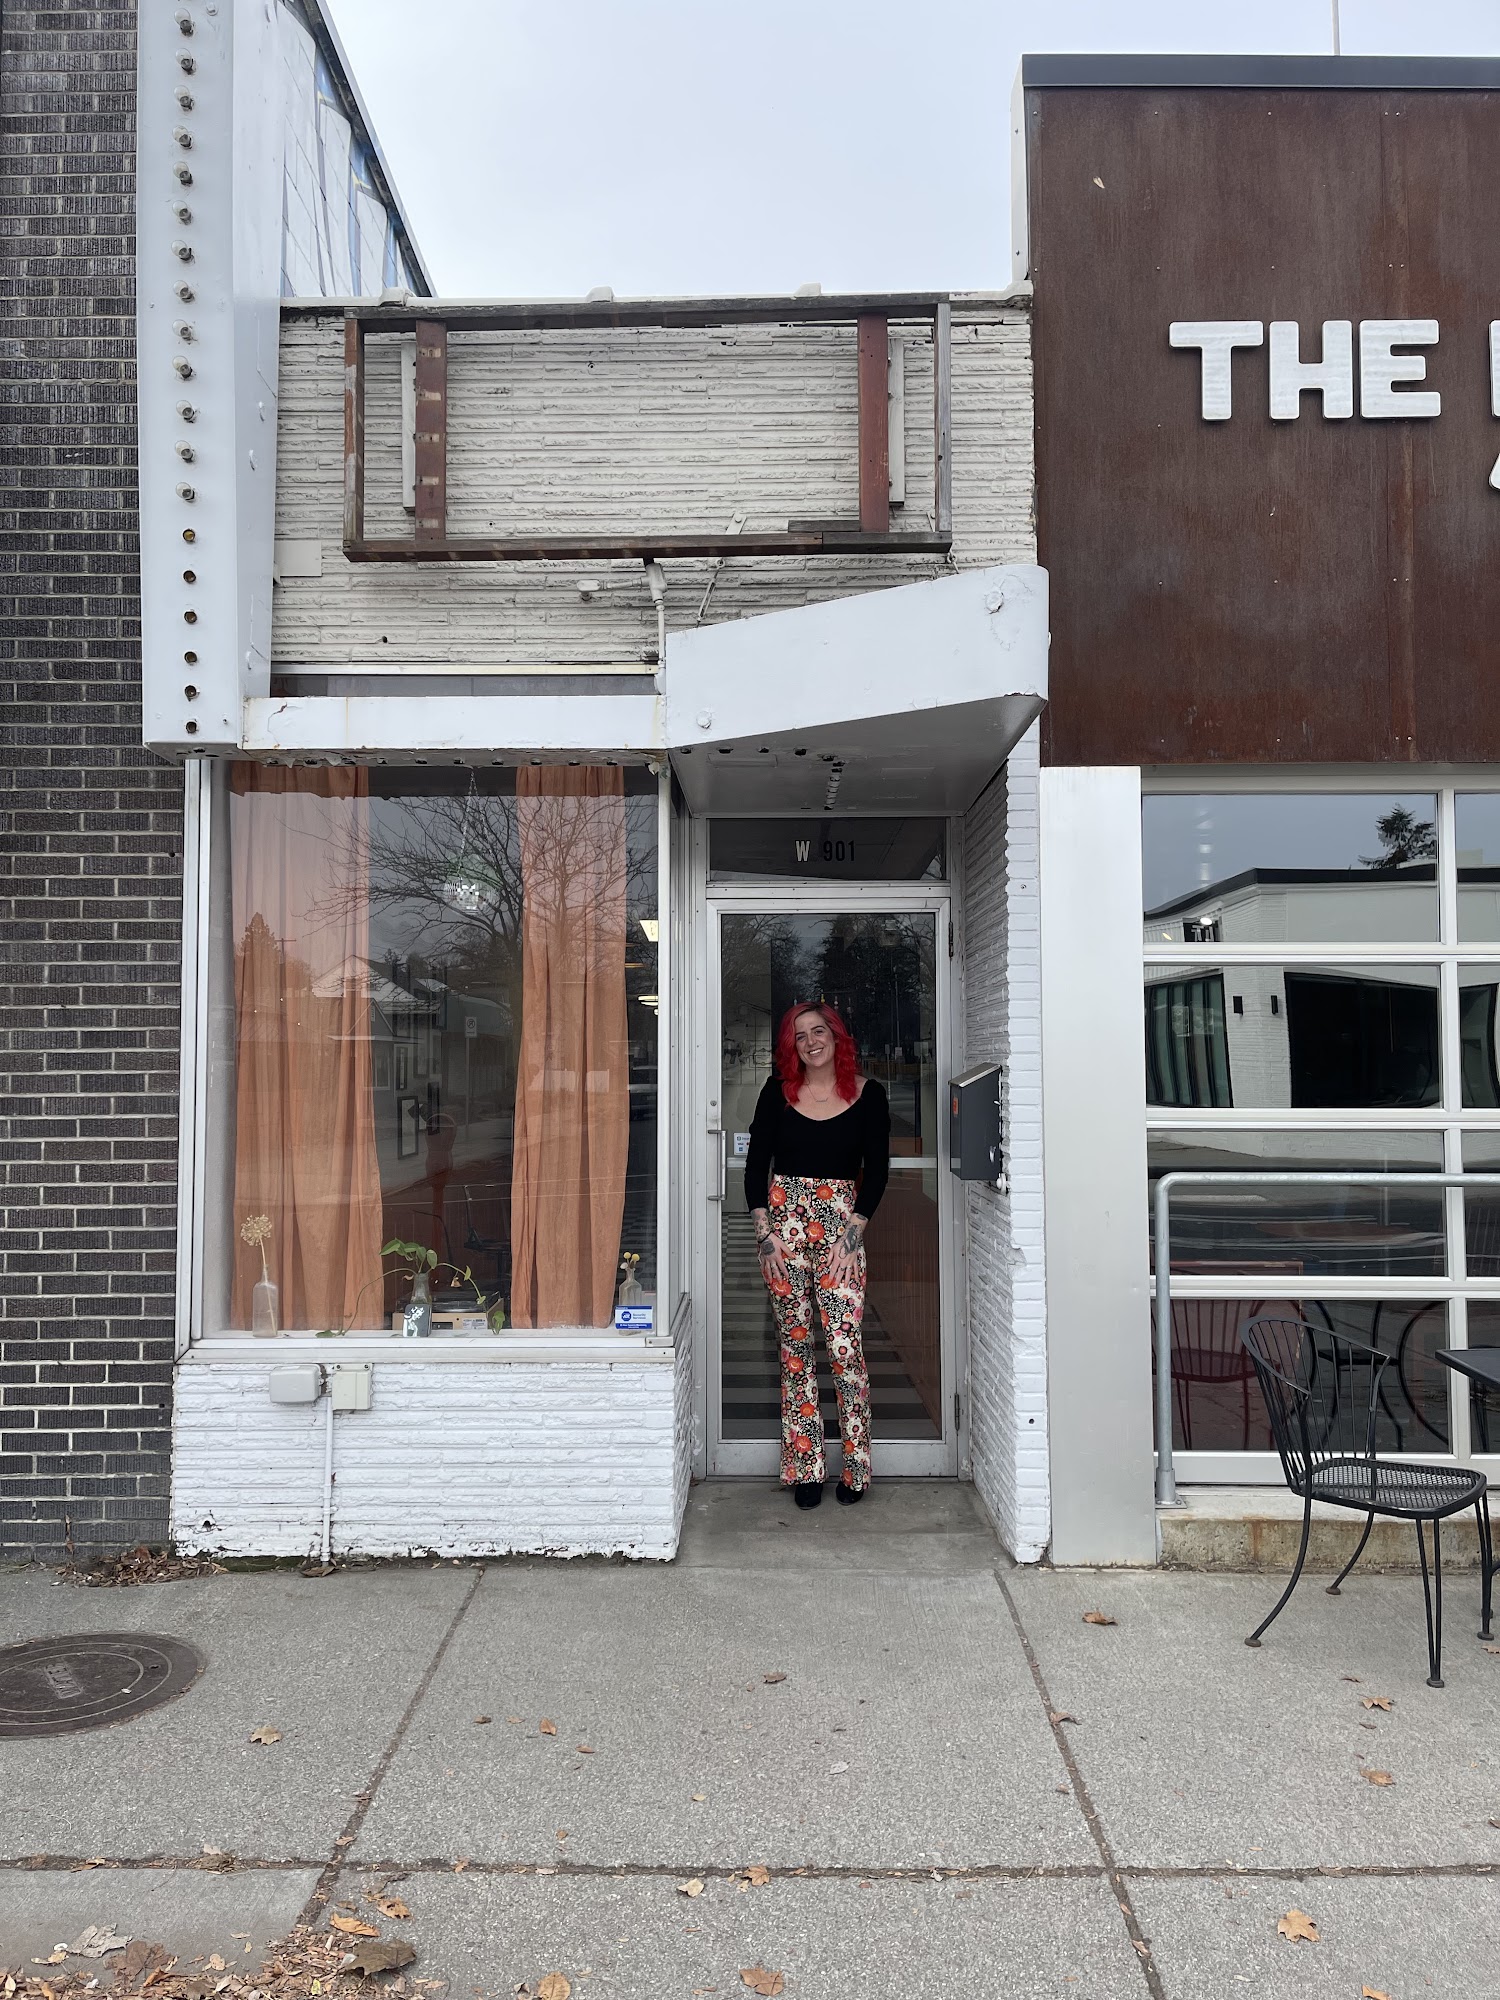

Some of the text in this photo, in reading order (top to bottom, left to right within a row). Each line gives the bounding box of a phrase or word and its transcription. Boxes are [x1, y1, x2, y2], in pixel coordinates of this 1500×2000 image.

[1169, 319, 1442, 421] THE
[795, 840, 855, 862] W 901
